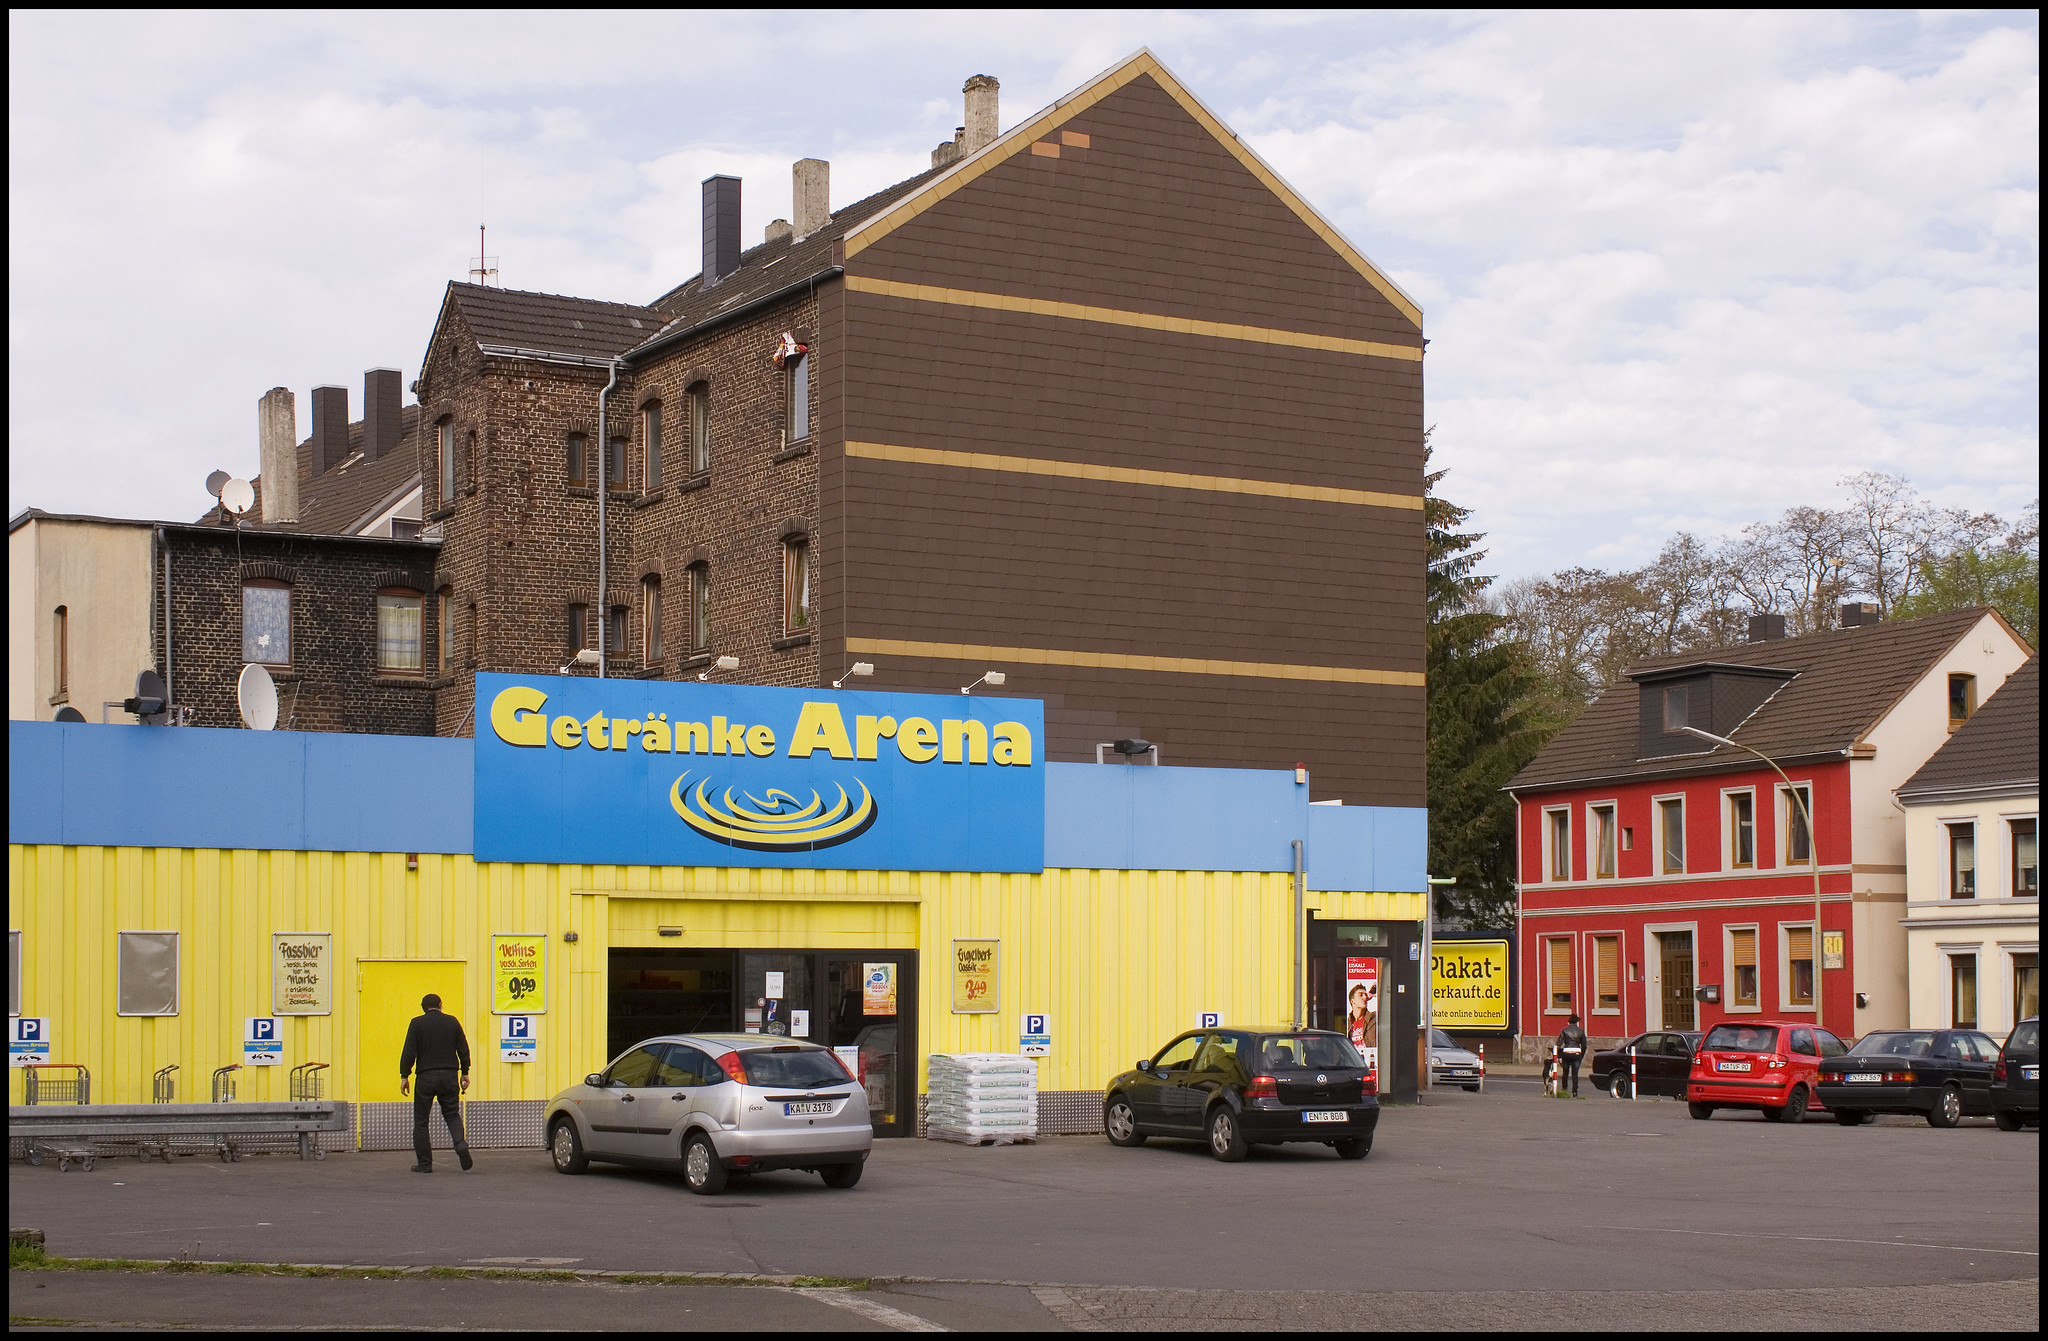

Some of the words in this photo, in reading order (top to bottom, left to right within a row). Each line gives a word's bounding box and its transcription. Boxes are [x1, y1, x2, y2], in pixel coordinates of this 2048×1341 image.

[490, 686, 775, 757] Getränke
[788, 701, 1033, 766] Arena
[287, 975, 319, 984] Markt
[1432, 985, 1501, 998] erkauft.de
[513, 1019, 526, 1036] P
[1030, 1017, 1041, 1032] P
[1205, 1015, 1215, 1028] P
[22, 1021, 37, 1038] P
[257, 1021, 271, 1038] P
[790, 1104, 801, 1113] KA
[805, 1103, 811, 1112] V
[812, 1103, 832, 1112] 3178
[1308, 1112, 1320, 1120] EN
[1323, 1112, 1329, 1120] G
[1330, 1112, 1344, 1120] 808
